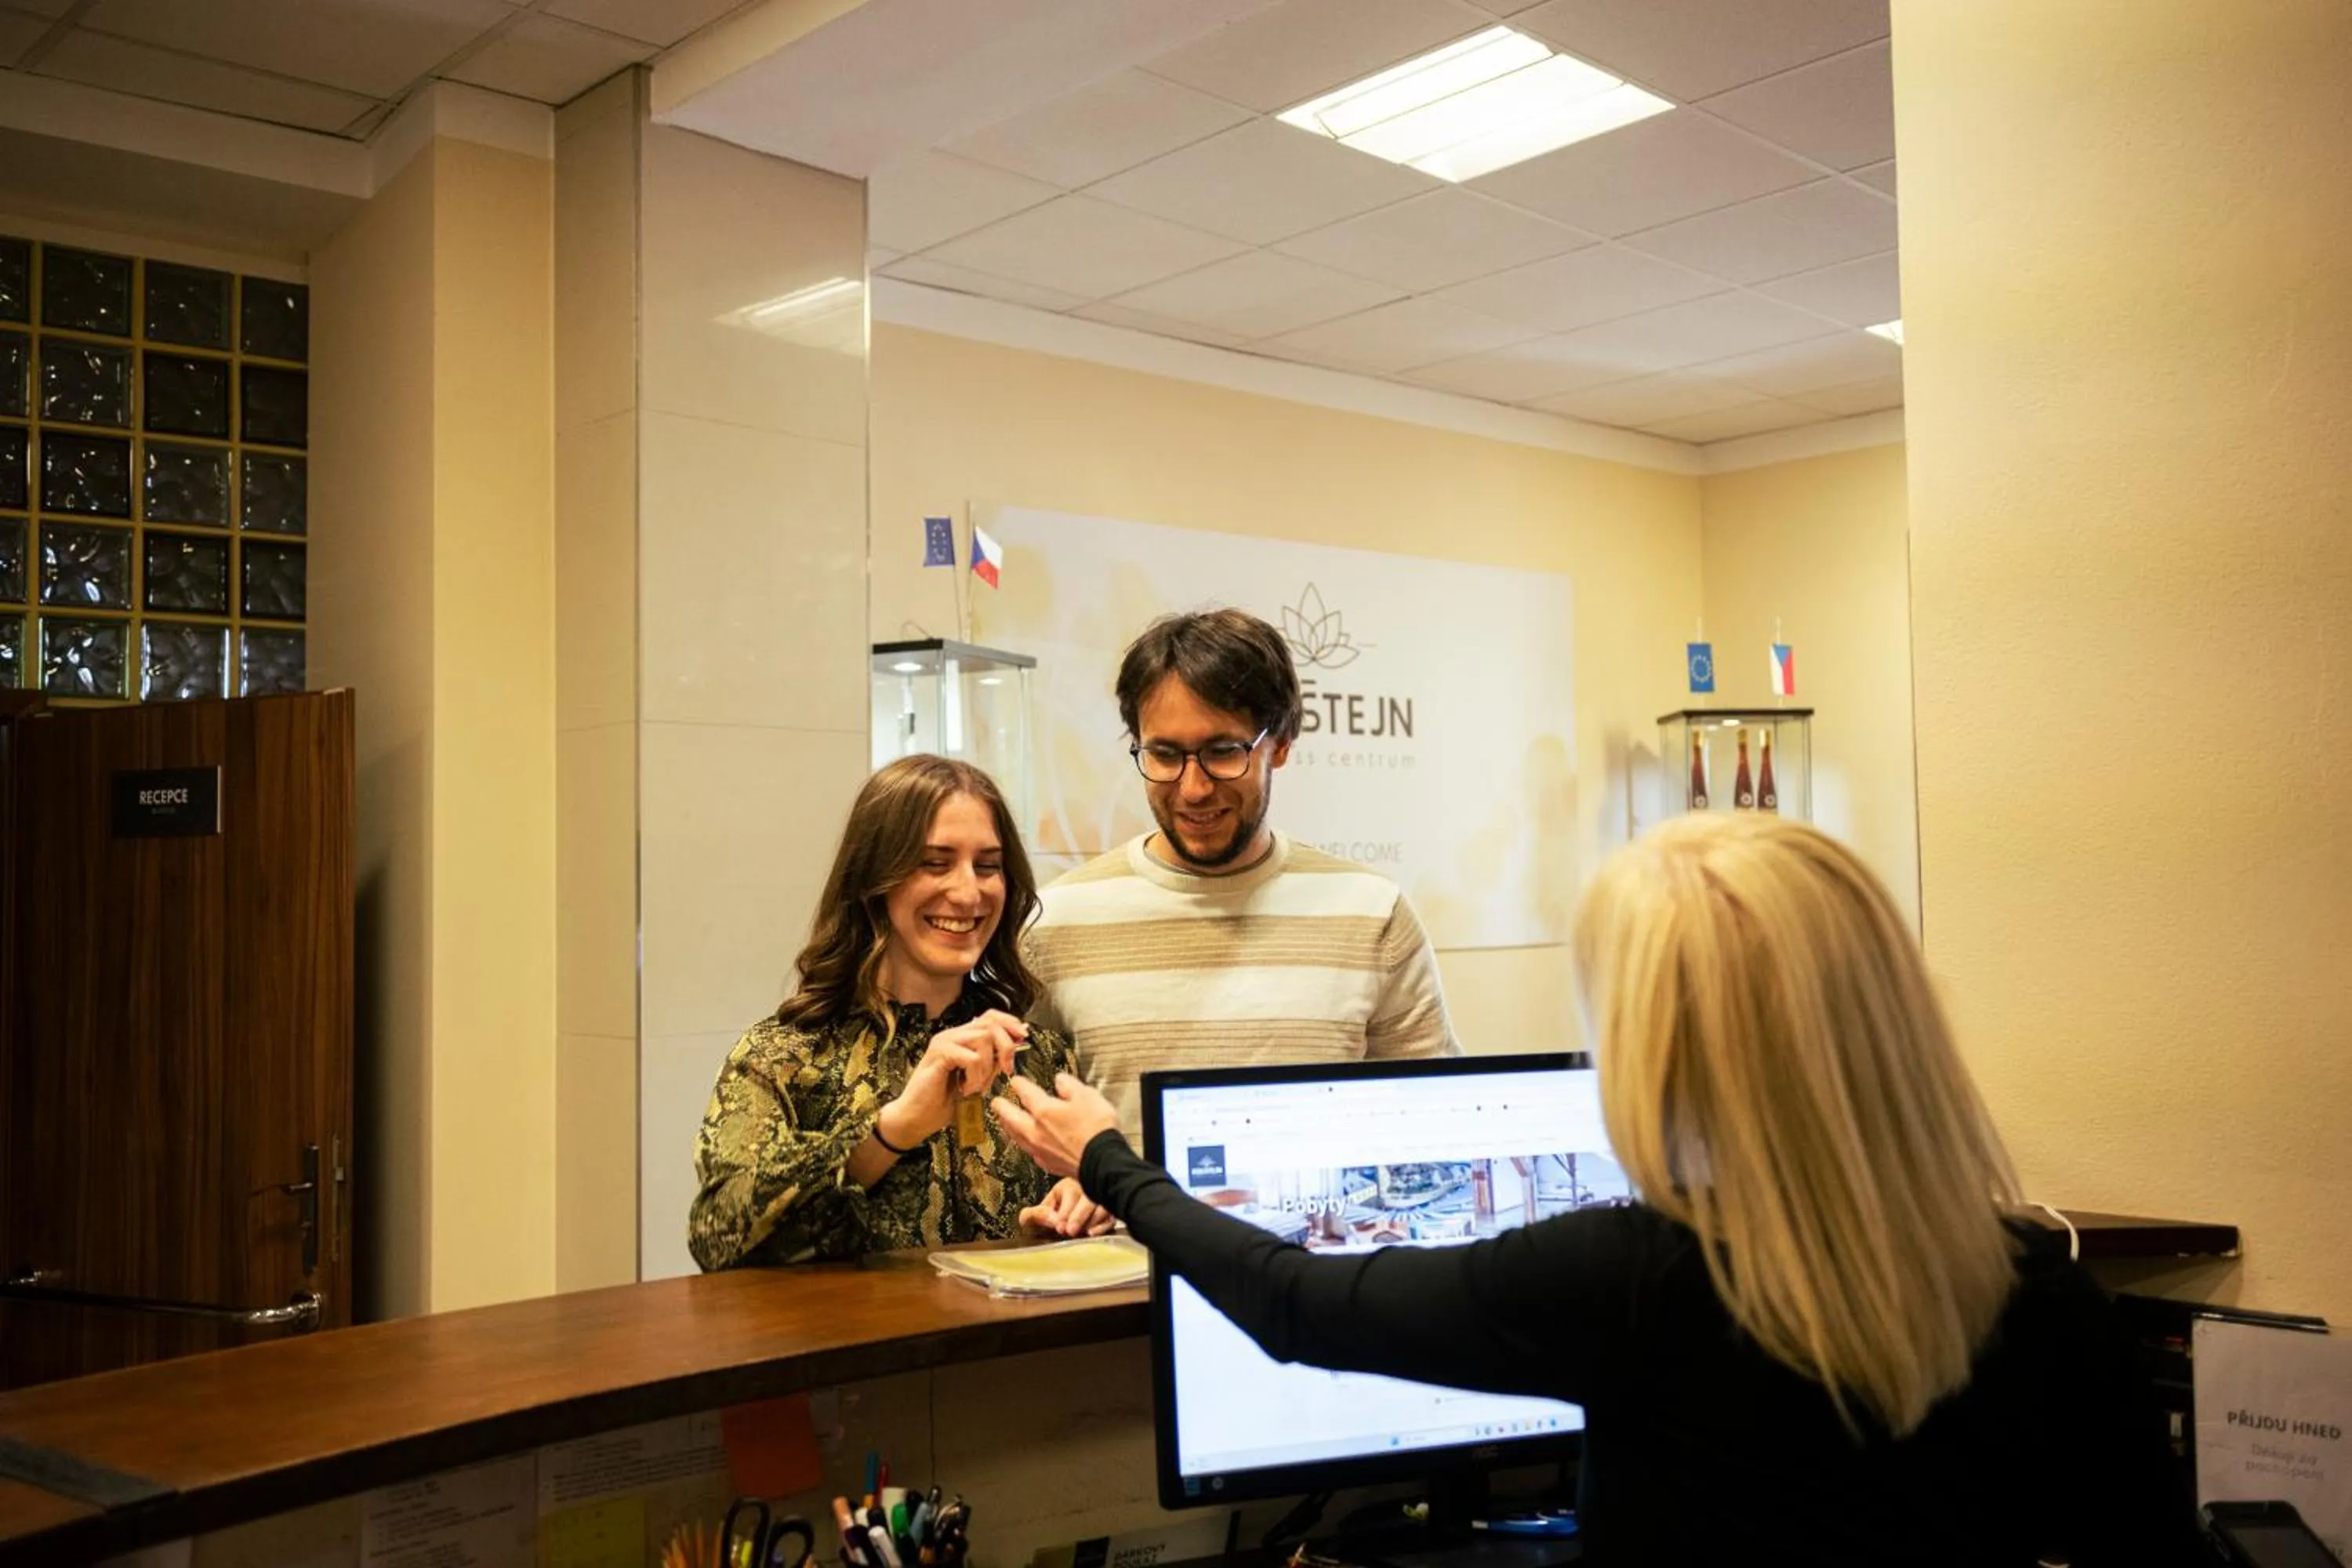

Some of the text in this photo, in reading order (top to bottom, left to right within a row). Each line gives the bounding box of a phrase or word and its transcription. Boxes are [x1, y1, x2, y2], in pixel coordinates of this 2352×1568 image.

[1301, 680, 1412, 737] ŠTEJN
[1327, 750, 1416, 770] centrum
[140, 789, 187, 804] RECEPCE
[1283, 1196, 1345, 1217] Pobyty
[2227, 1410, 2341, 1440] PŘIJDU HNED
